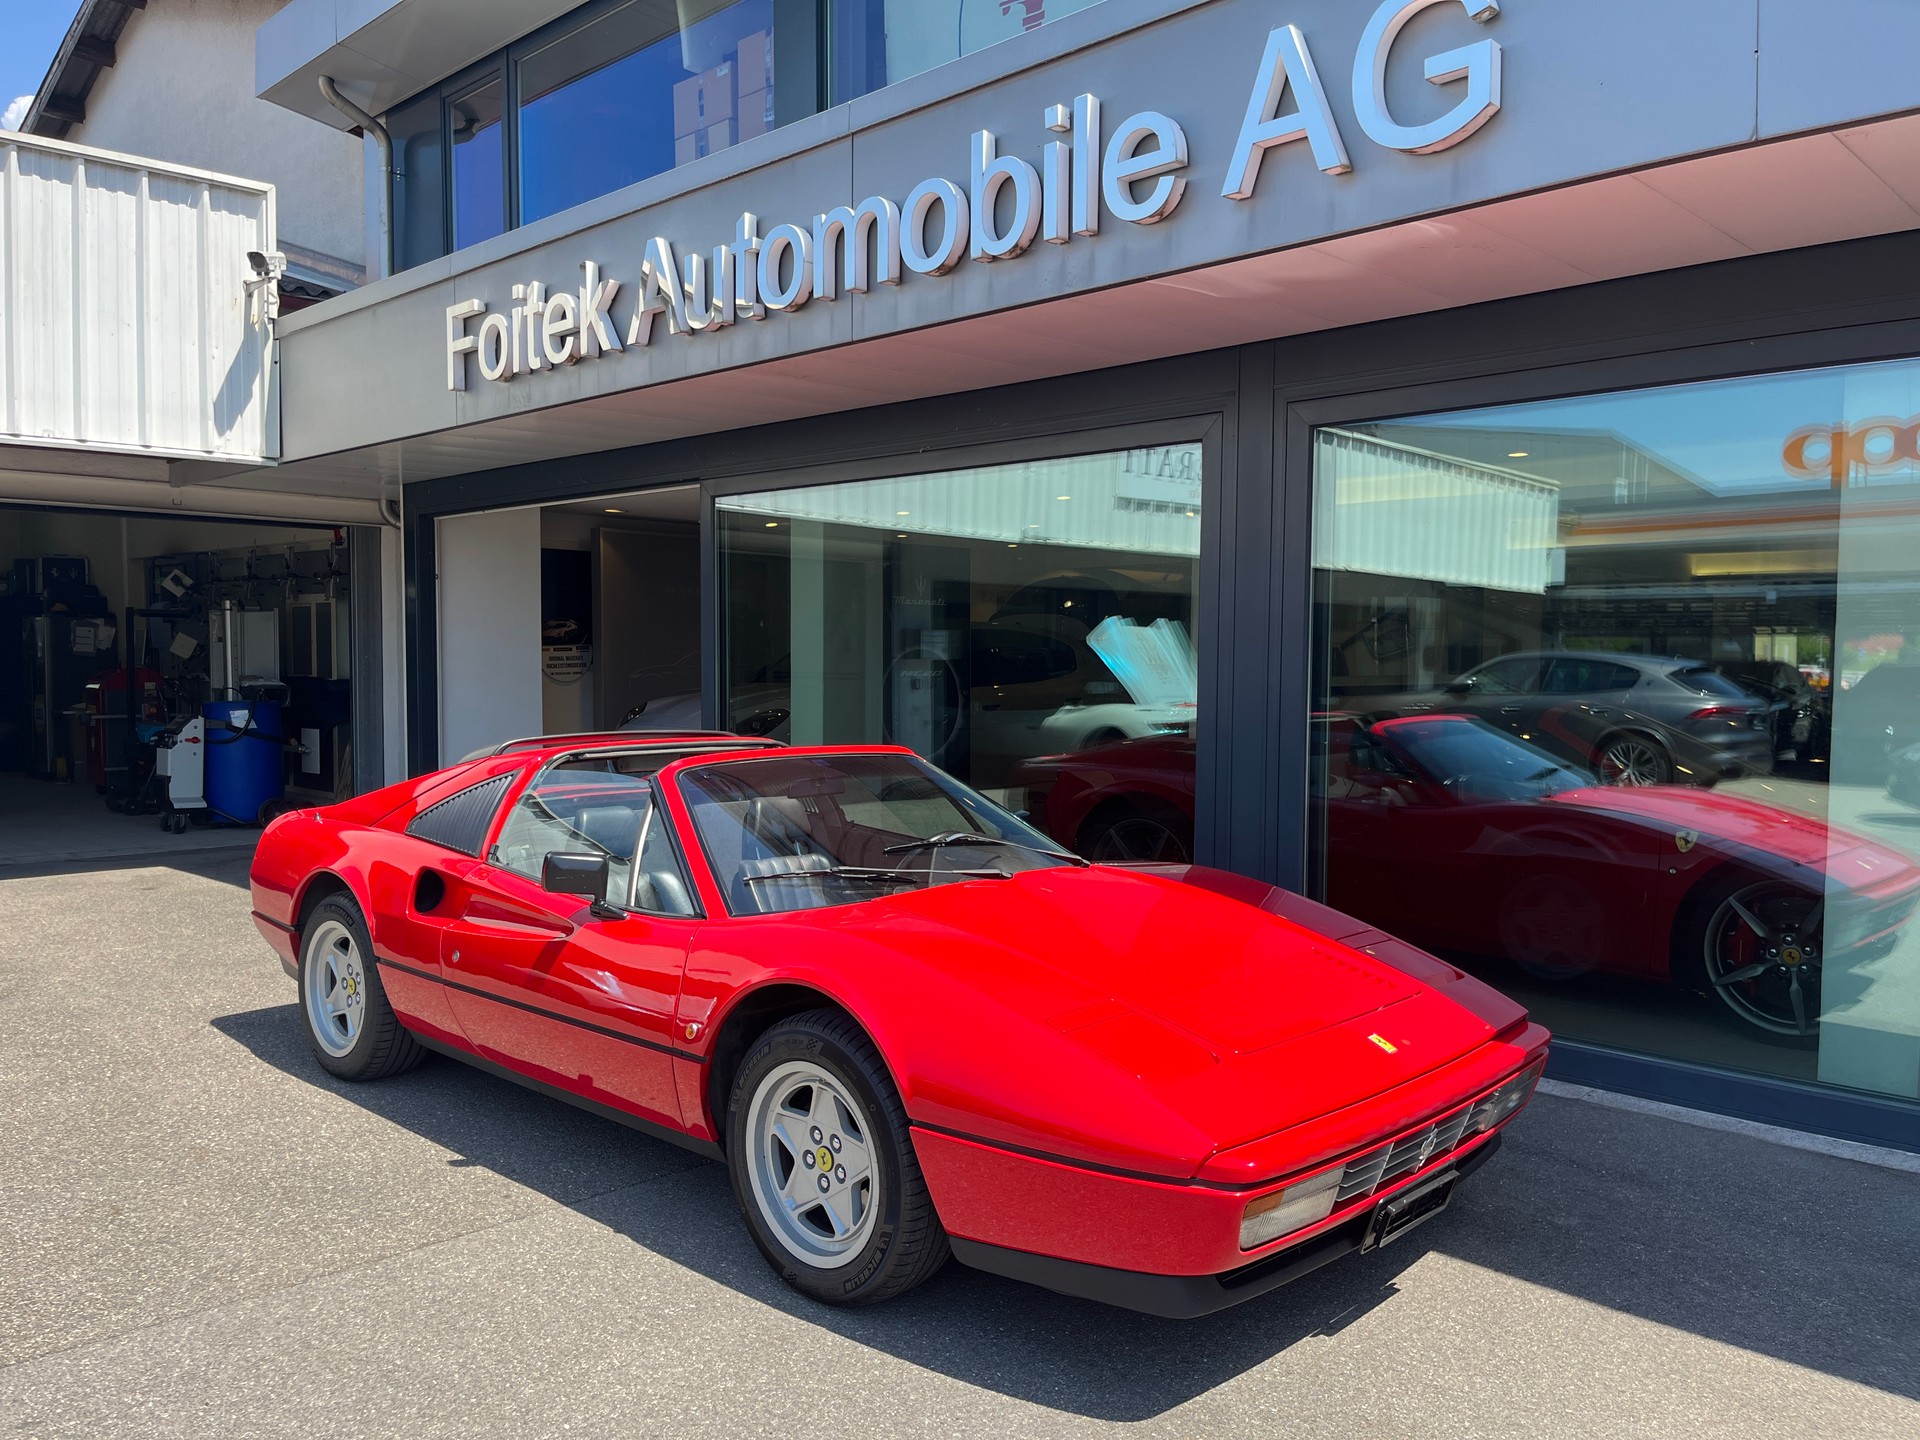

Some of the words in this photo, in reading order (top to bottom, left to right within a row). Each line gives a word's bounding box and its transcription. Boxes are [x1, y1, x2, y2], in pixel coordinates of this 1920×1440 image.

[446, 260, 623, 392] Foitek
[627, 93, 1188, 348] Automobile
[1221, 0, 1502, 200] AG
[738, 1044, 770, 1088] MICHELIN
[844, 1249, 882, 1292] MICHELIN
